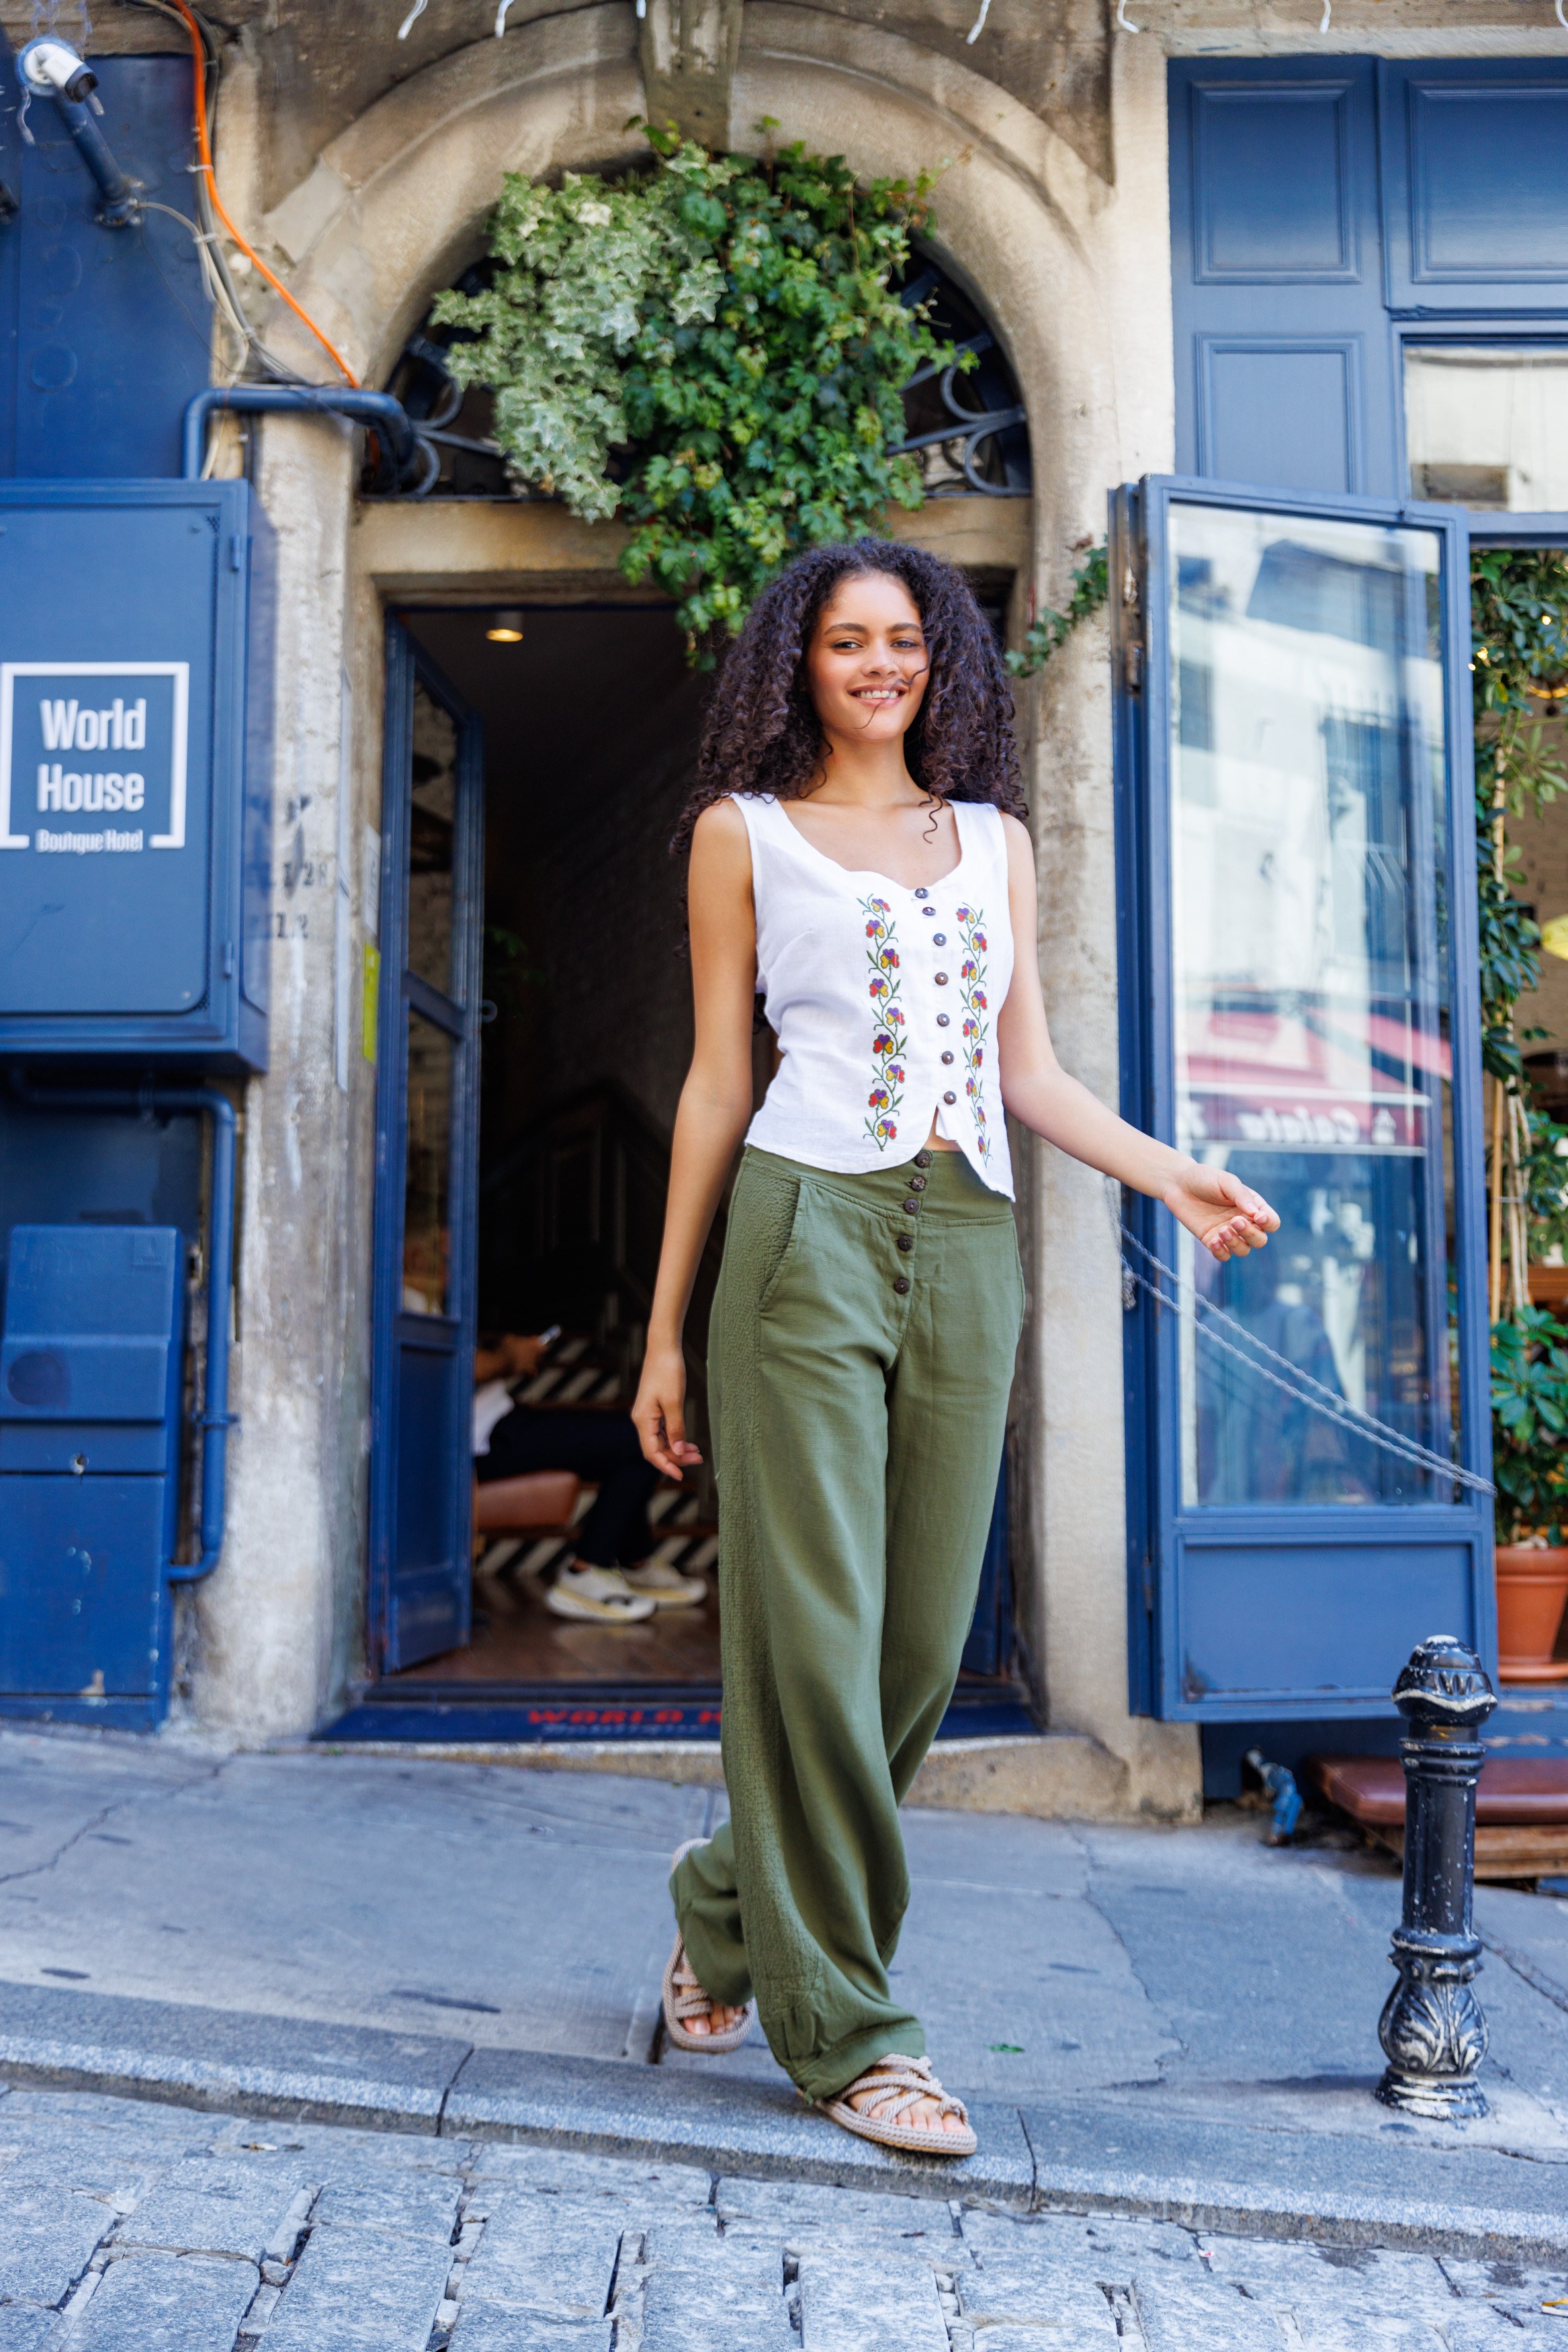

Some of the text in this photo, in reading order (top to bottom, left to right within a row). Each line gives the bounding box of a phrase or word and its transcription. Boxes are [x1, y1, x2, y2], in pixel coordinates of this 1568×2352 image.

[39, 698, 146, 751] World
[37, 763, 144, 812] House
[35, 828, 144, 855] Boutique Hotel
